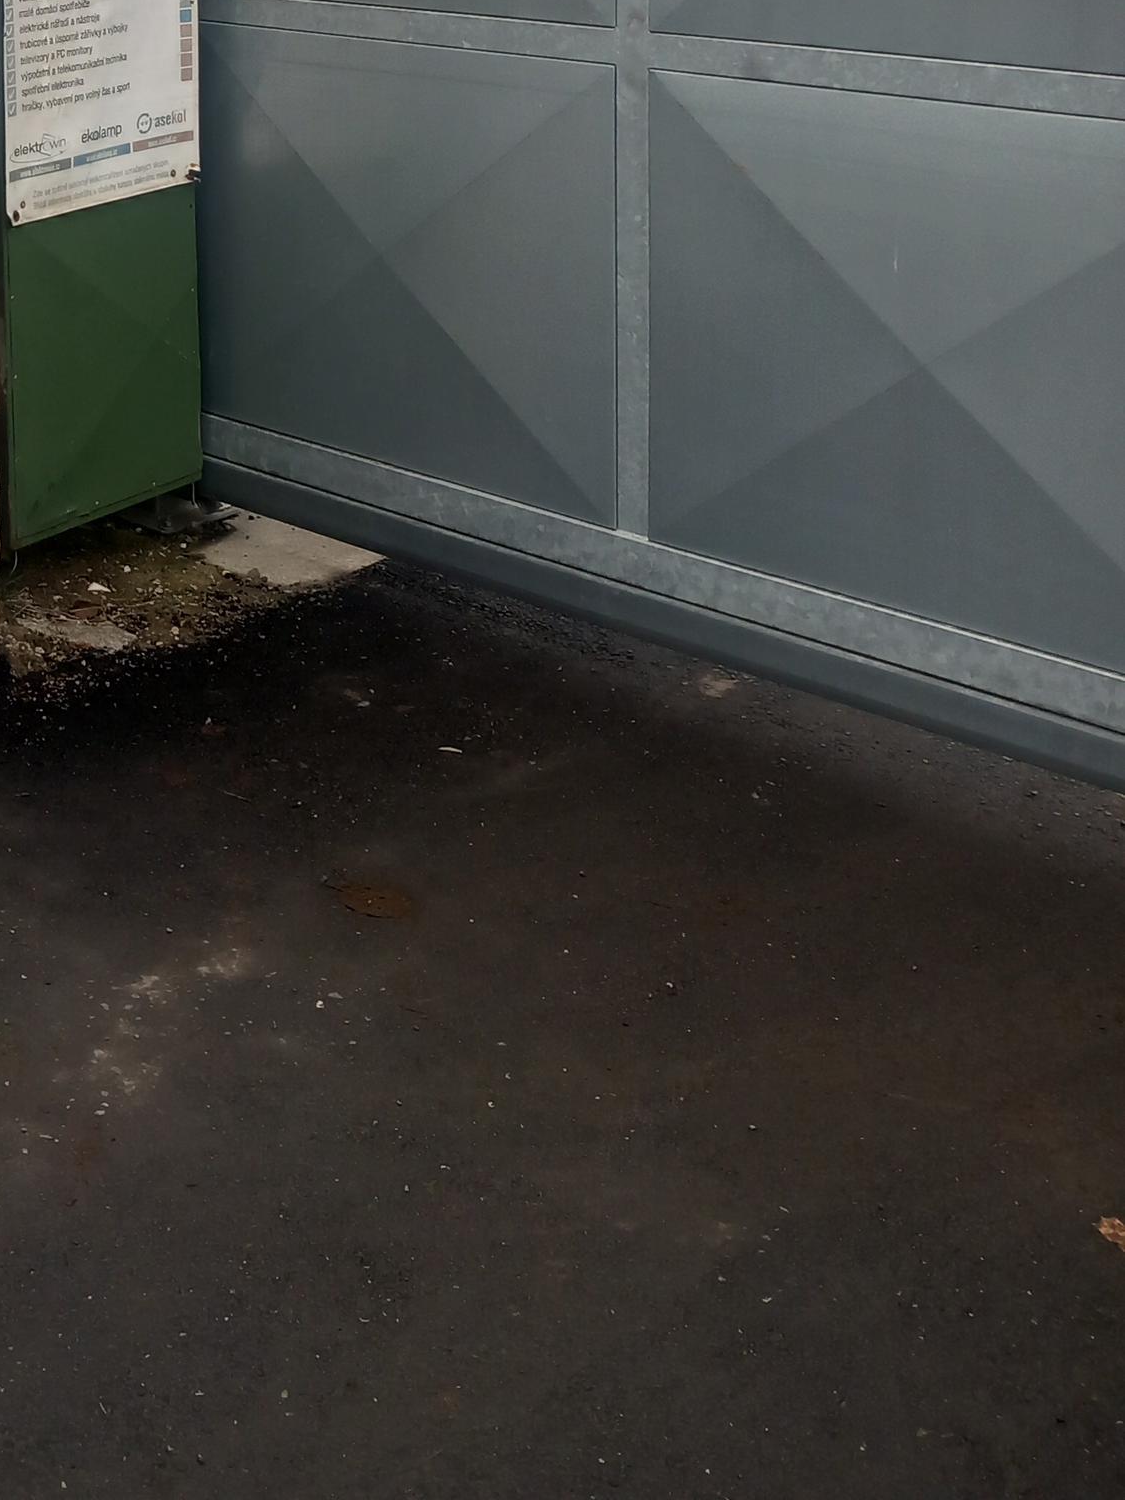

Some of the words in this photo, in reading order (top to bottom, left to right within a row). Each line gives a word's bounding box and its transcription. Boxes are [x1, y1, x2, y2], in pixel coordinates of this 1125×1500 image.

[36, 4, 58, 15] domácí
[59, 0, 90, 13] spotřebiče
[19, 21, 49, 34] elektrické
[20, 53, 49, 65] televizory
[56, 49, 65, 59] PC
[66, 46, 93, 57] monitory
[20, 67, 50, 83] výpočetní
[51, 78, 84, 91] elektronika
[74, 93, 85, 104] pro
[85, 87, 101, 100] volný
[101, 86, 111, 96] čas
[117, 82, 130, 95] sport
[81, 124, 122, 143] ekolamp
[154, 109, 187, 127] asekol
